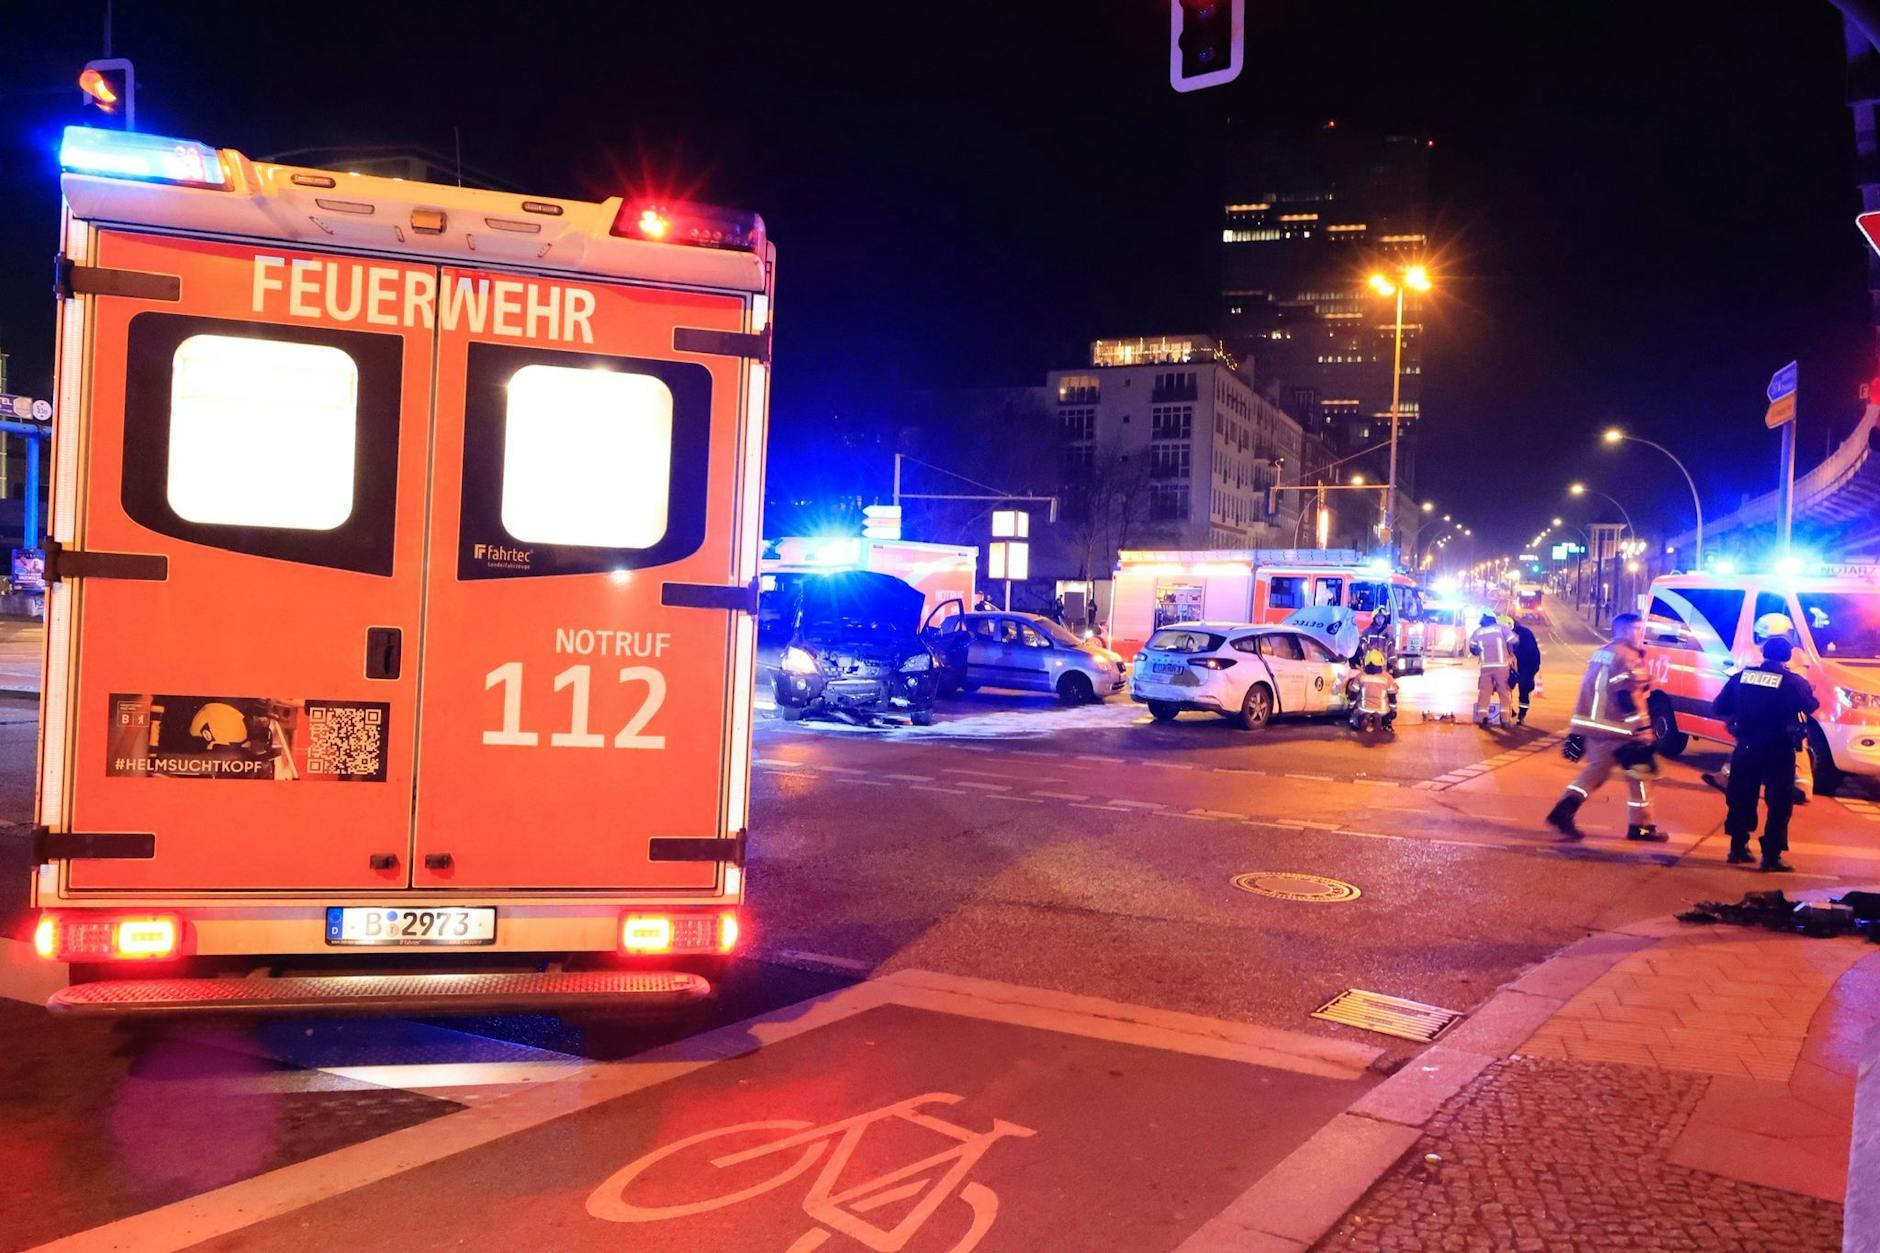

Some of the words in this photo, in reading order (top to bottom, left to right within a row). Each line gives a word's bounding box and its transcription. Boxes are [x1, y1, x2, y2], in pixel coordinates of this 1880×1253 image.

[252, 255, 596, 344] FEUERWEHR
[487, 544, 530, 562] fahrtec
[555, 628, 671, 657] NOTRUF
[483, 661, 667, 750] 112
[114, 758, 263, 773] #HELMSUCHTKOPF
